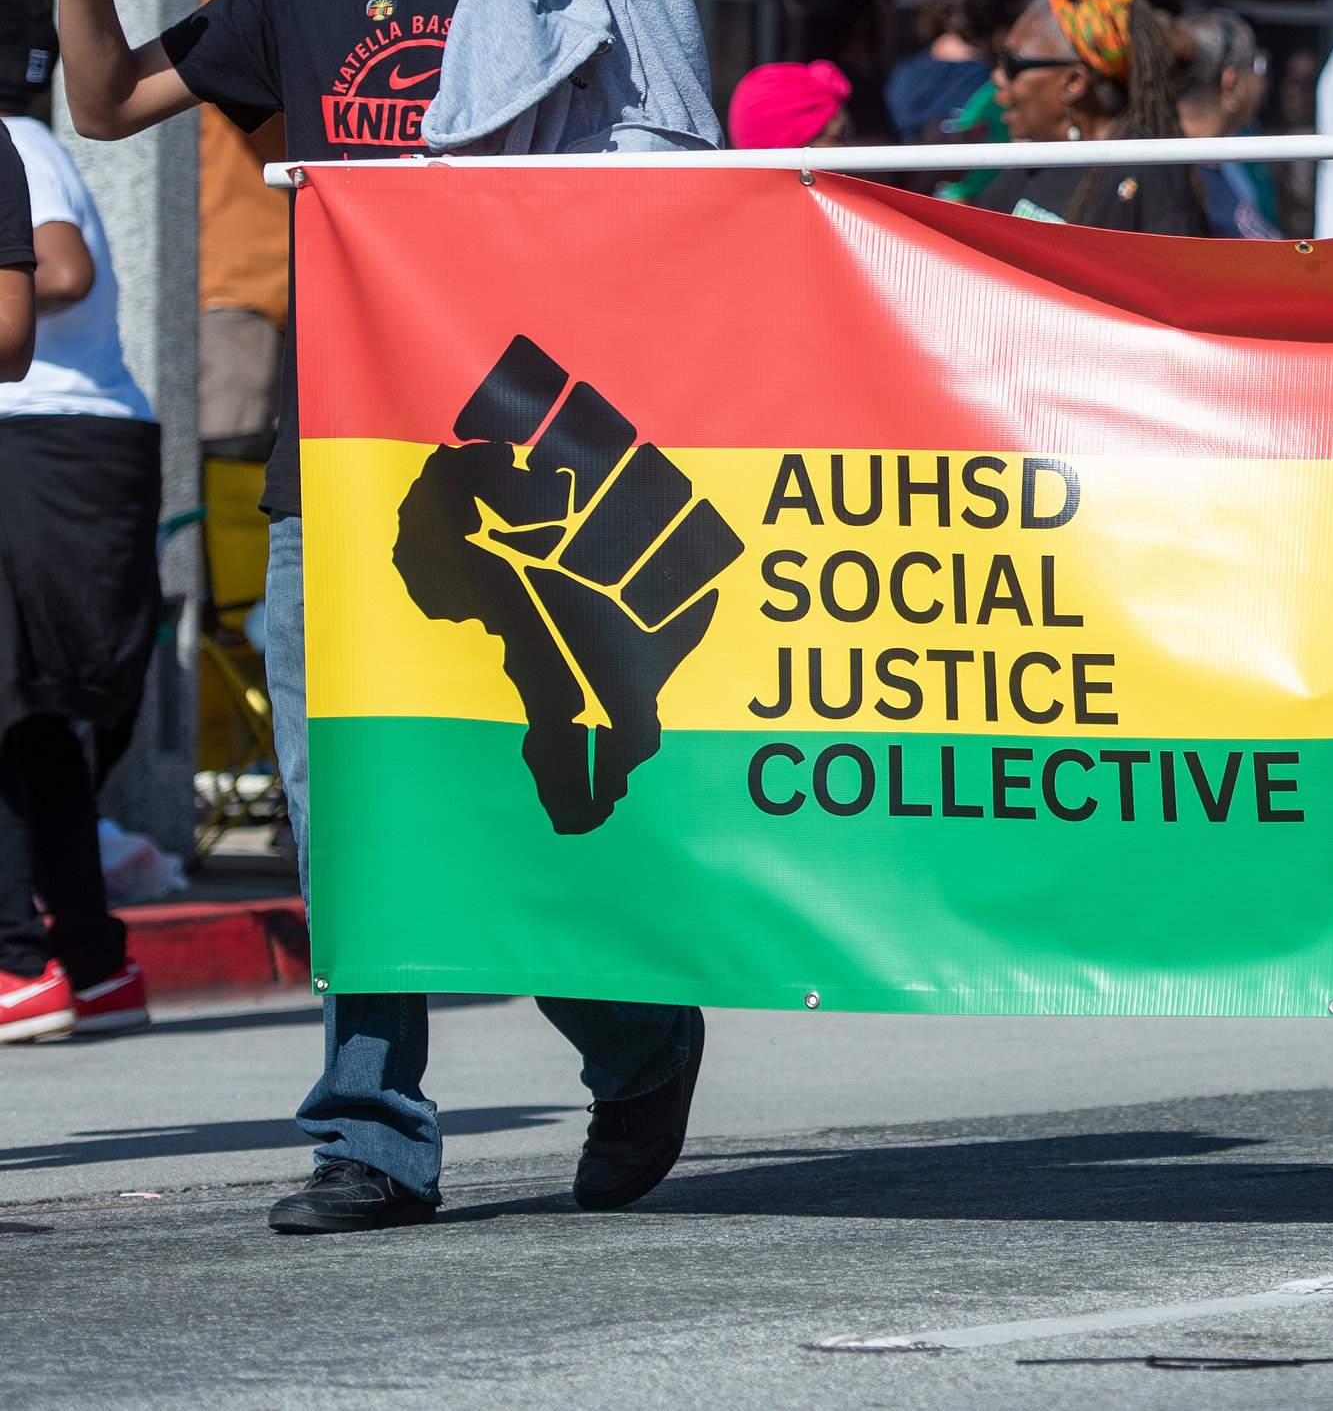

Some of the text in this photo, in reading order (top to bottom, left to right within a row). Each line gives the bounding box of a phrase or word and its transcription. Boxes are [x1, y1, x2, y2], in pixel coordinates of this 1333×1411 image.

[332, 20, 402, 94] KATELLA
[762, 453, 1081, 529] AUHSD
[760, 549, 1084, 628] SOCIAL
[747, 647, 1119, 726] JUSTICE
[747, 742, 1306, 824] COLLECTIVE
